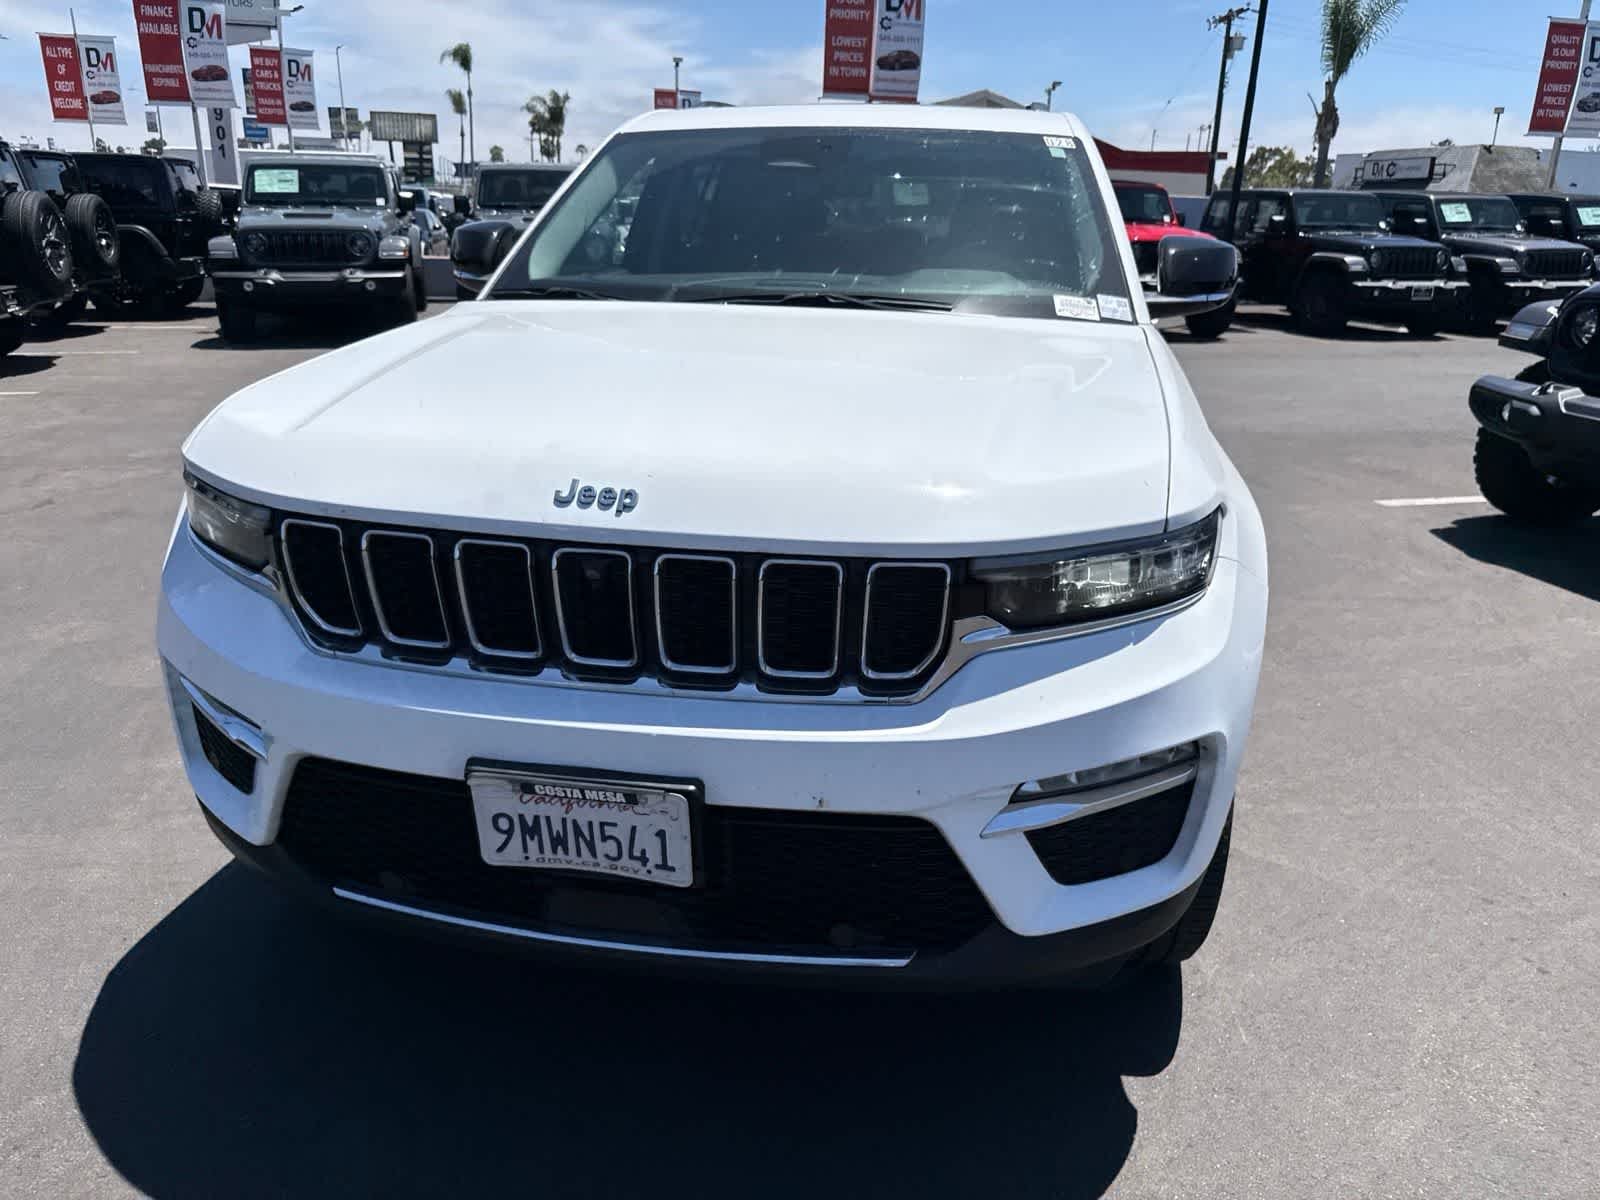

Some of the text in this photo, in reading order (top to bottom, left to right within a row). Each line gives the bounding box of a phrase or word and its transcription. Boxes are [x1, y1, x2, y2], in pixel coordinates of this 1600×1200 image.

[140, 5, 174, 18] FINANCE
[829, 8, 871, 20] PRIORITY
[140, 22, 179, 35] AVAILABLE
[832, 36, 867, 48] LOWEST
[1551, 34, 1580, 46] QUALITY
[46, 46, 73, 59] ALL TYPE
[57, 63, 66, 75] OF
[1545, 60, 1577, 70] PRIORITY
[255, 69, 273, 79] CARS
[54, 80, 75, 92] CREDIT
[255, 82, 282, 91] TRUCKS
[53, 96, 83, 109] WELCOME
[553, 477, 640, 518] Jeep
[534, 784, 627, 804] COSTA MESA
[491, 811, 677, 873] 9MWN541
